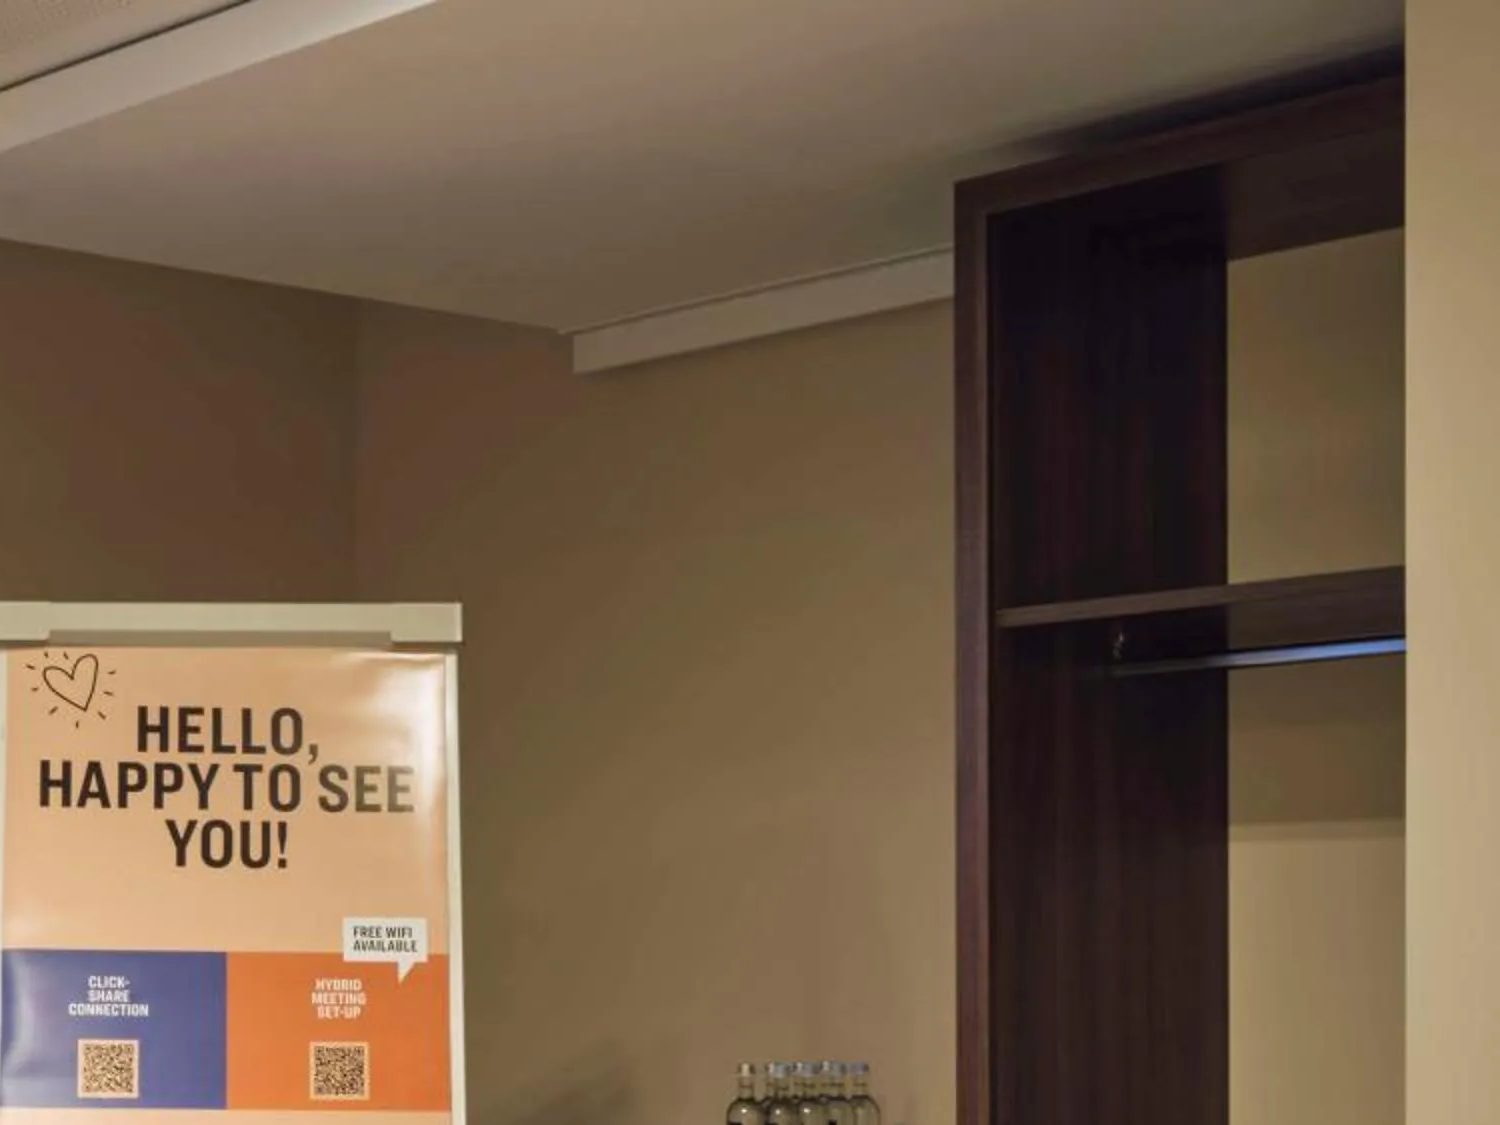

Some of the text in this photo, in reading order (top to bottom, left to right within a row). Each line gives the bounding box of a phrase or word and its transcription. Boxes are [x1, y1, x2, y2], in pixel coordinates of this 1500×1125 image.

[136, 704, 320, 764] HELLO,
[38, 759, 415, 813] HAPPY TO SEE
[165, 818, 289, 869] YOU!
[353, 925, 413, 939] FREE WIFI
[353, 939, 418, 953] AVAILABLE
[88, 975, 131, 989] CLICK-
[315, 978, 362, 991] HYBRID
[88, 989, 130, 1003] SHARE
[311, 992, 367, 1005] MEETING
[68, 1003, 149, 1017] CONNECTION
